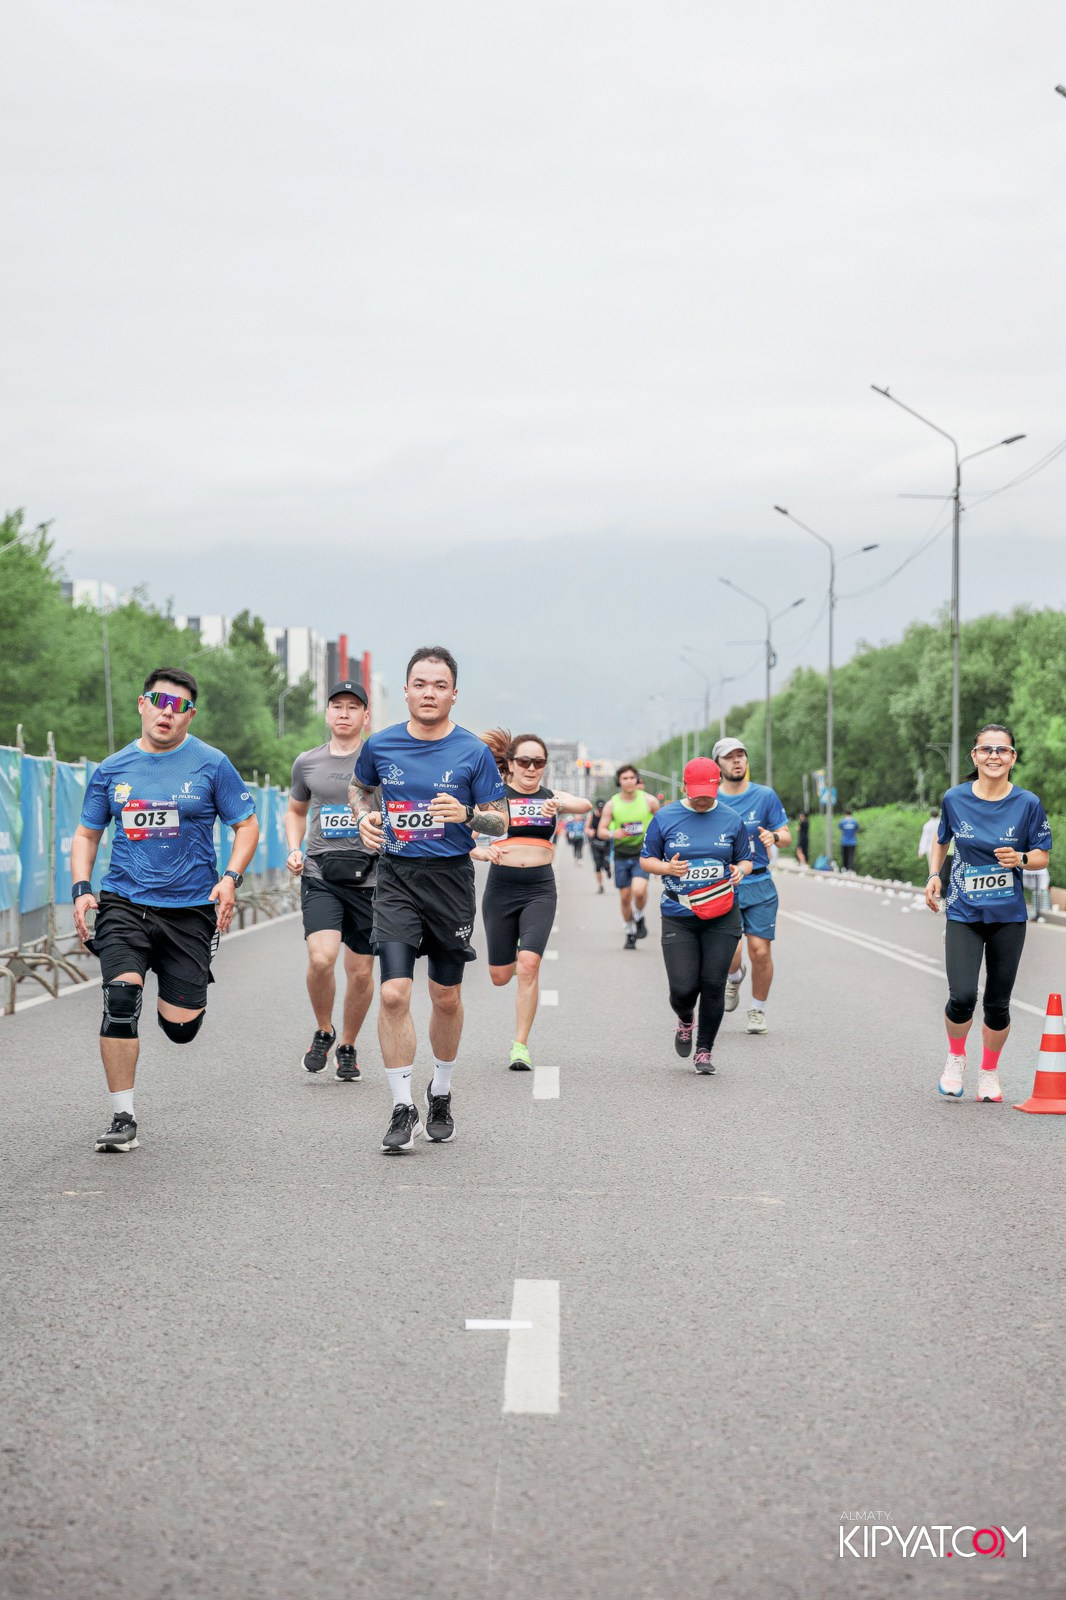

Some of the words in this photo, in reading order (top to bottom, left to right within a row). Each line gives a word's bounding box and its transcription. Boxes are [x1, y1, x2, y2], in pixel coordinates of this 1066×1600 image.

[133, 811, 168, 827] 013
[396, 813, 434, 828] 508
[686, 867, 718, 880] 1892
[972, 874, 1007, 890] 1106
